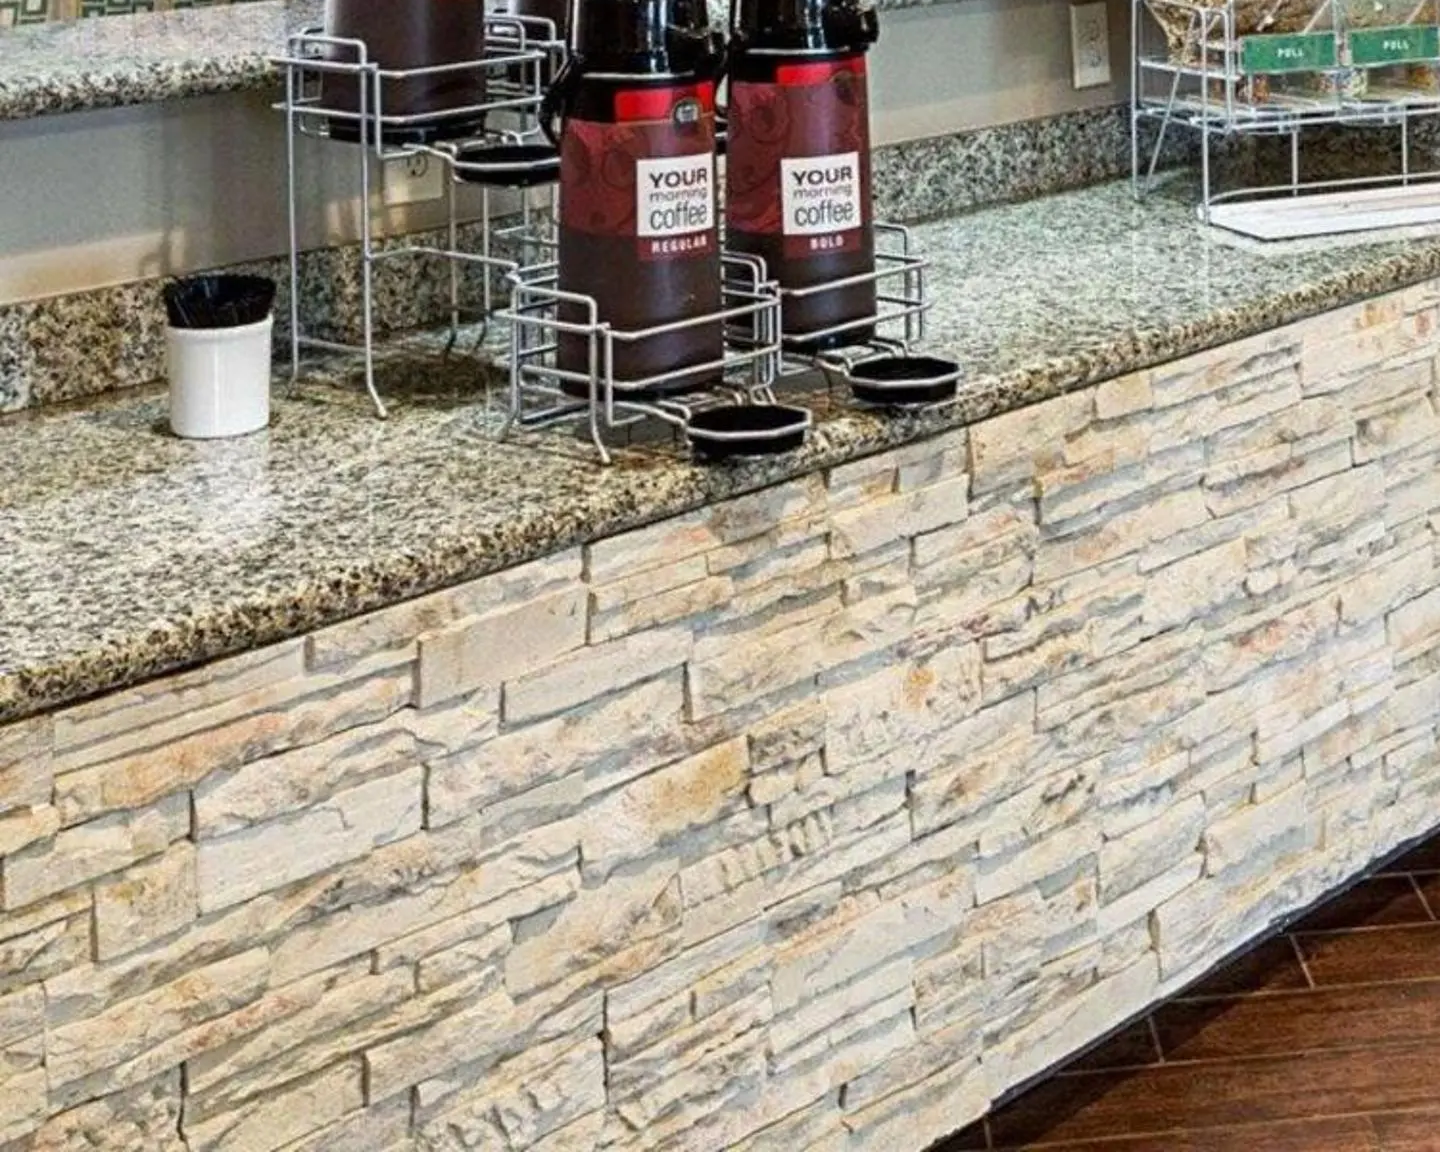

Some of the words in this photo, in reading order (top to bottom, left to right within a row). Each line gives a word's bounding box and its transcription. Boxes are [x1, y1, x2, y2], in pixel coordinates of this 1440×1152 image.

[648, 167, 708, 188] YOUR
[793, 165, 853, 186] YOUR
[649, 188, 708, 203] morning
[793, 183, 853, 199] morning
[650, 201, 708, 230] coffee
[794, 199, 854, 227] coffee
